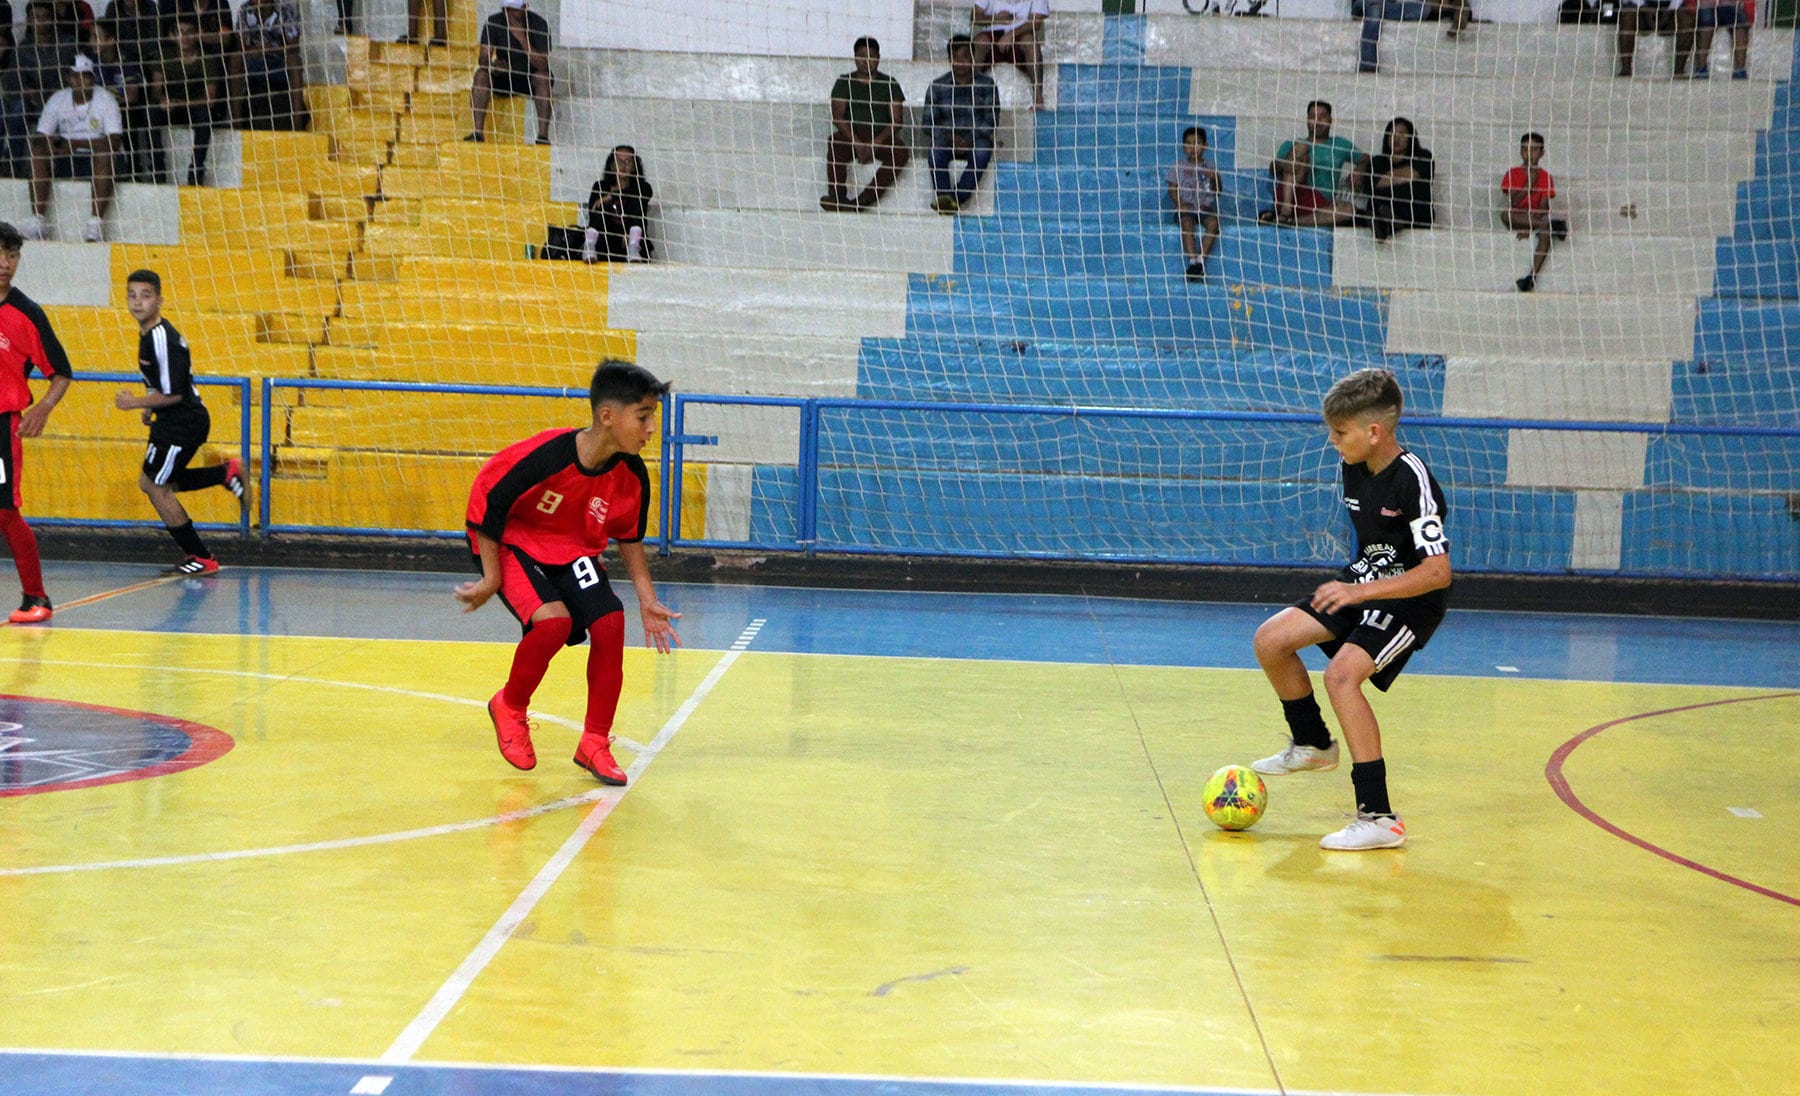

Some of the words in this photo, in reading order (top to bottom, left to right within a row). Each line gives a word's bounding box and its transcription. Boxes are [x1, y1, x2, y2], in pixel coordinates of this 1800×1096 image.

[536, 489, 564, 515] 9
[1421, 520, 1442, 543] C
[572, 555, 600, 590] 9
